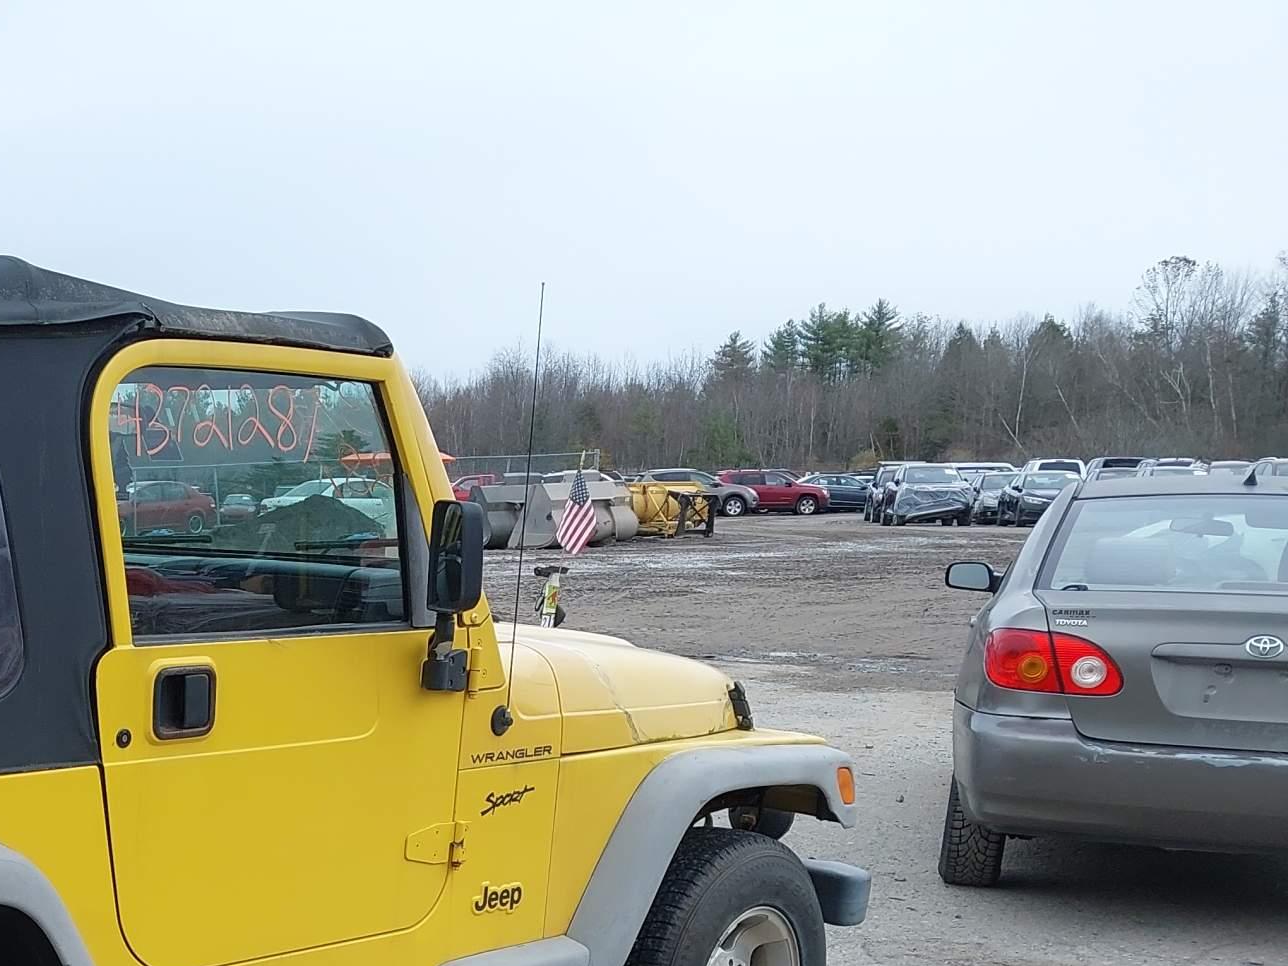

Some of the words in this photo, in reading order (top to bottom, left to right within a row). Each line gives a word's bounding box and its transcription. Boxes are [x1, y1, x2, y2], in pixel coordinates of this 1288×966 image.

[1055, 618, 1089, 627] TOYOTA
[471, 745, 553, 764] WRANGLER
[473, 884, 523, 913] Jeep
